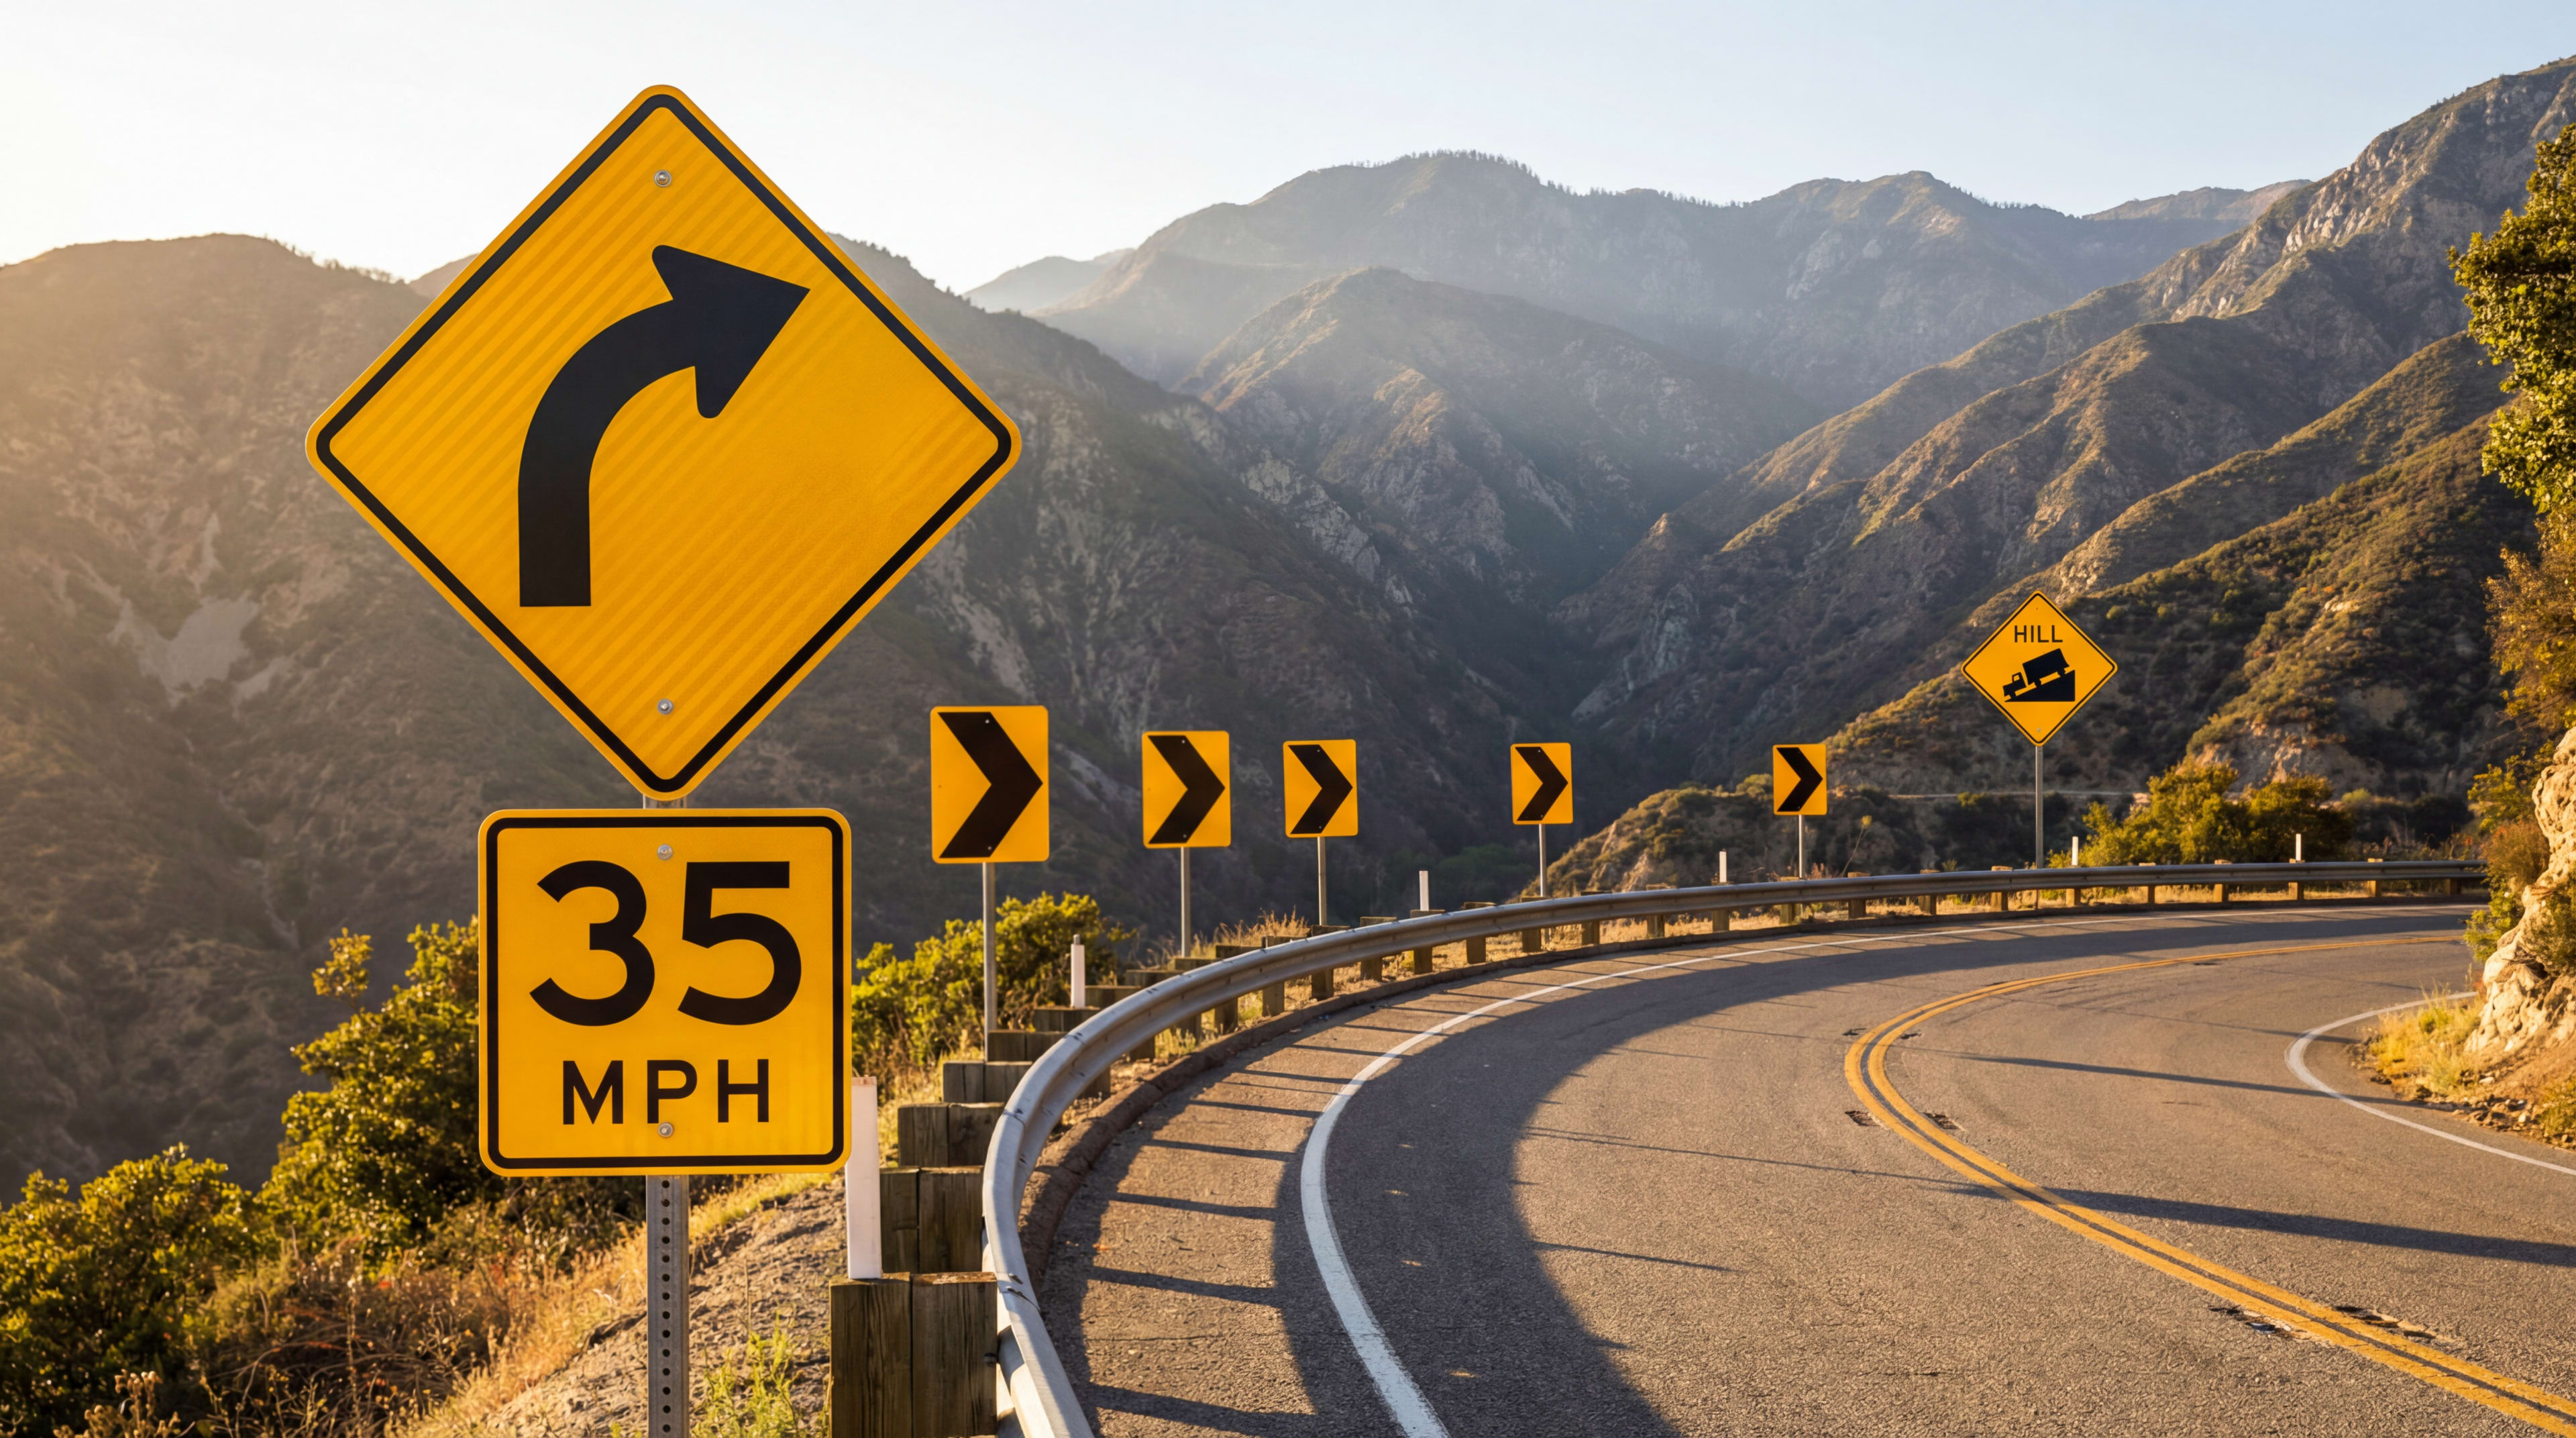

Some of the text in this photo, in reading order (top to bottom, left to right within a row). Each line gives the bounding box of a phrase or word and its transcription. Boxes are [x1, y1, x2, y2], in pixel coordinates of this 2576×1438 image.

[2014, 625, 2063, 643] HILL
[529, 860, 802, 1027] 35
[562, 1059, 769, 1125] MPH
